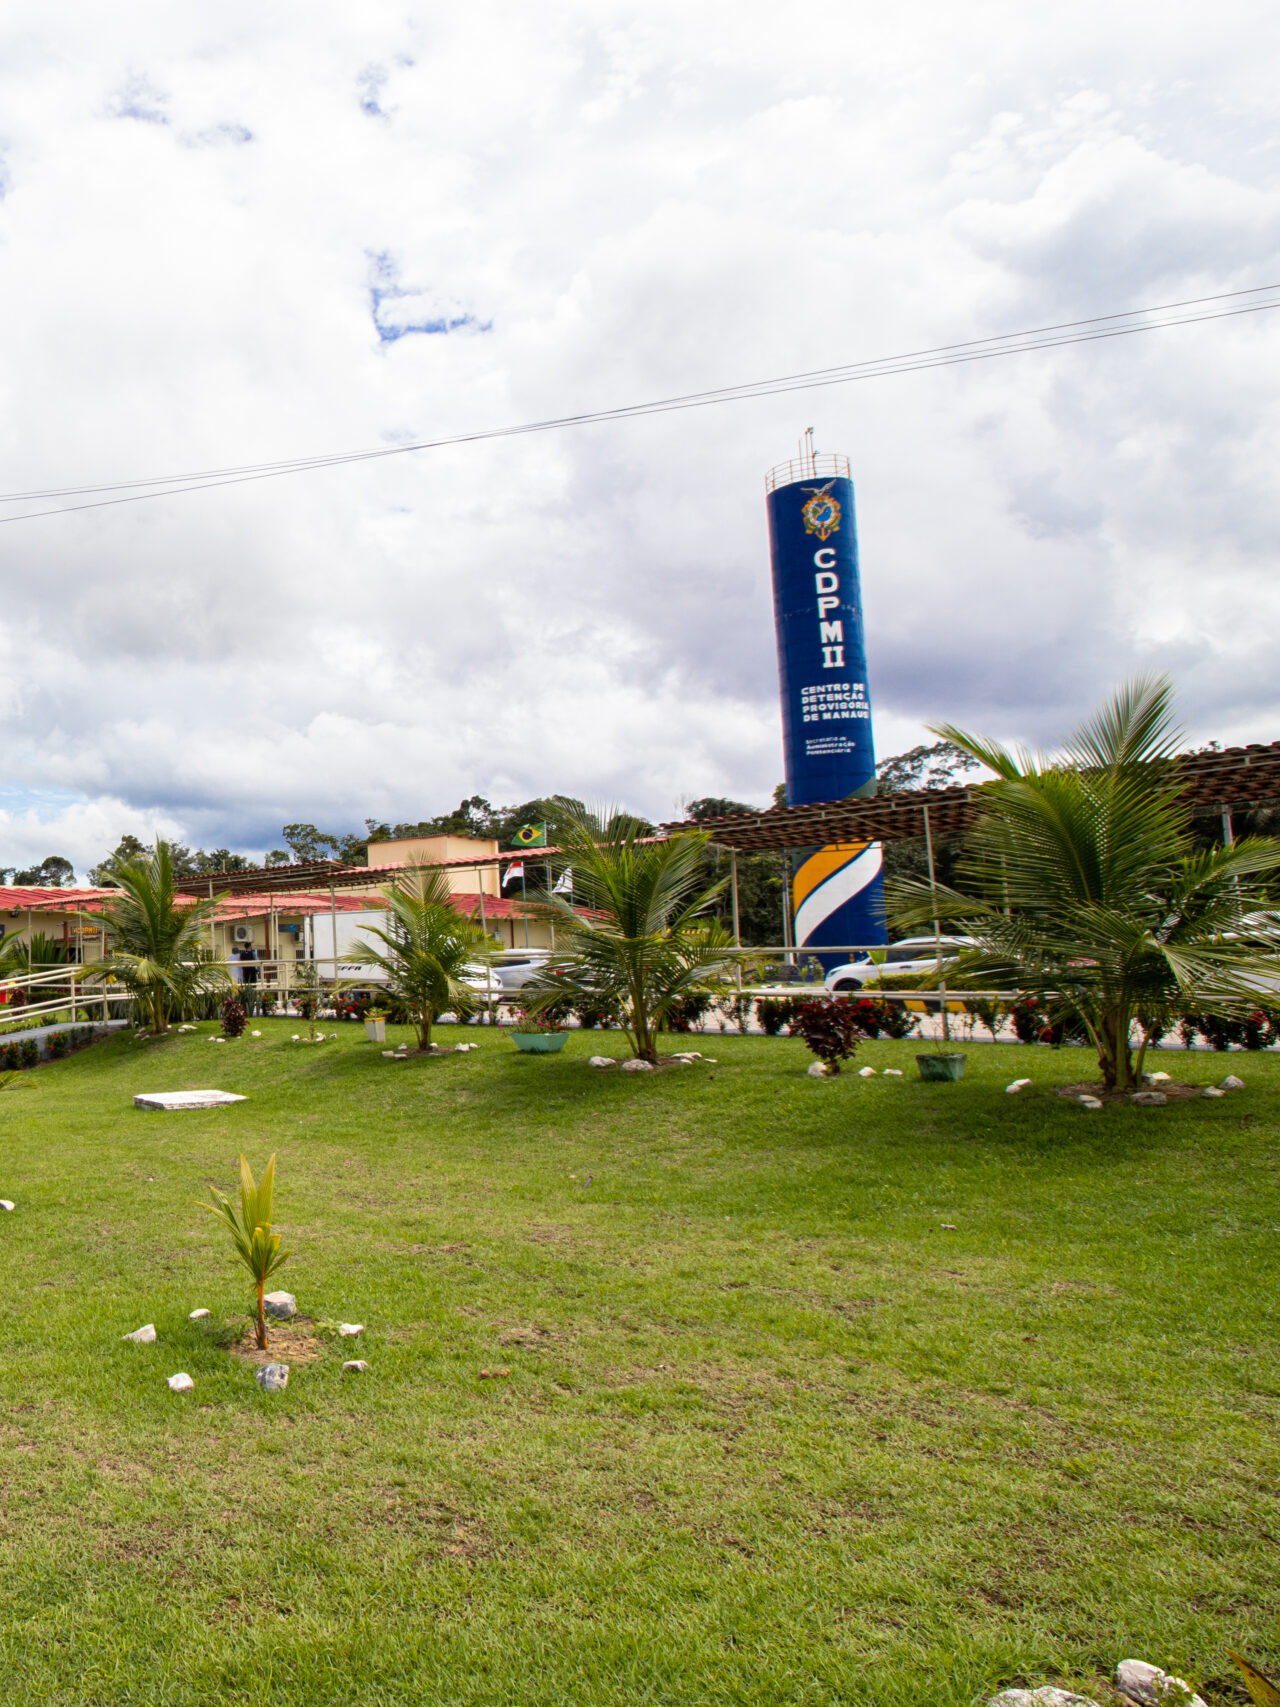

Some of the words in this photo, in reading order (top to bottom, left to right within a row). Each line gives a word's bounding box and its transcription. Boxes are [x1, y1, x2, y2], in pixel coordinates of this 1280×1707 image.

[801, 683, 850, 695] CENTRO
[852, 683, 865, 691] DE
[801, 691, 865, 704] DETENÇÃO
[802, 701, 869, 713] PROVISÓRIA
[803, 713, 819, 722] DE
[822, 711, 869, 720] MANAUS
